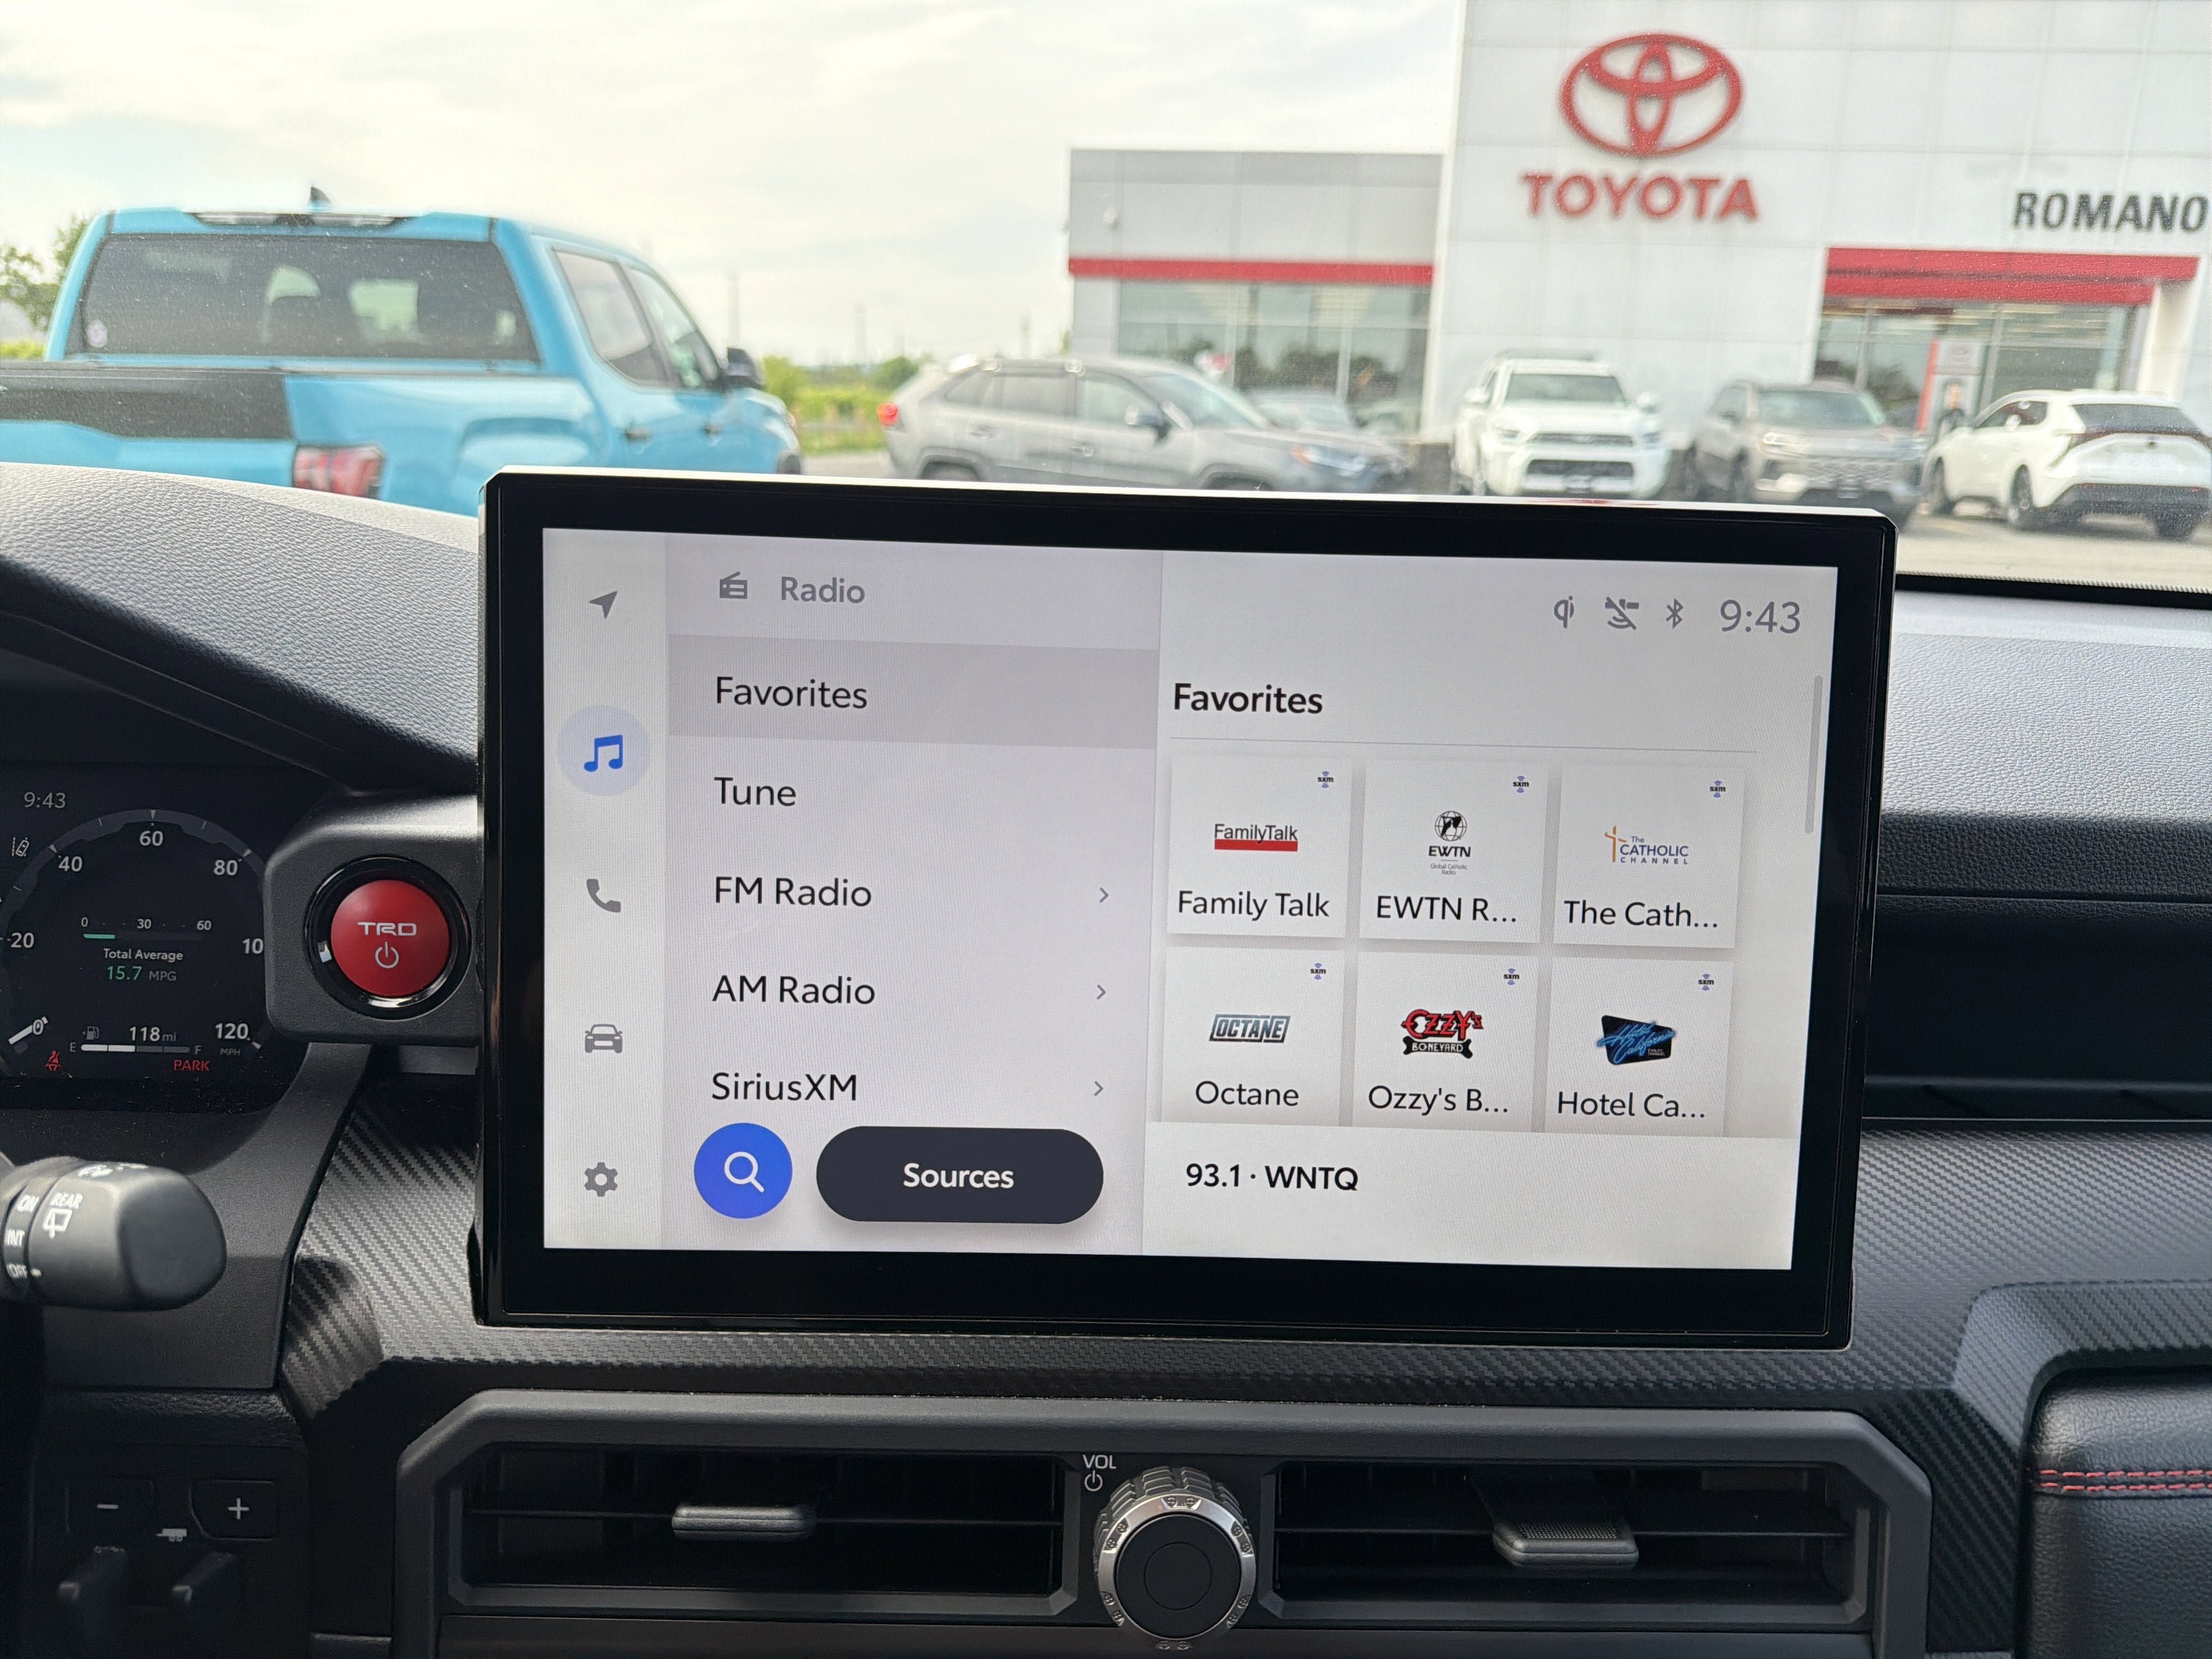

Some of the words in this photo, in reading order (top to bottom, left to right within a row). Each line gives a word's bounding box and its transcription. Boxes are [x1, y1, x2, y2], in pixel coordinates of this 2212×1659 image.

[1522, 173, 1759, 221] TOYOTA
[2013, 191, 2209, 233] ROMANO
[781, 576, 865, 604] Radio
[1720, 599, 1801, 634] 9:43
[716, 676, 867, 709] Favorites
[1174, 682, 1323, 714] Favorites
[714, 776, 797, 806] Tune
[24, 792, 66, 809] 9:43
[139, 830, 163, 847] 60
[1214, 823, 1298, 844] FamilyTalk
[1429, 845, 1471, 857] EWTN
[1620, 844, 1689, 857] CATHOLIC
[58, 856, 83, 872] 40
[213, 859, 238, 876] 80
[1620, 856, 1688, 865] CHANNEL
[715, 876, 763, 904] FM
[776, 877, 872, 907] Radio
[1178, 890, 1268, 921] Family
[1275, 892, 1329, 917] Talk
[1377, 895, 1462, 921] EWTN
[1564, 899, 1616, 925] The
[81, 917, 88, 927] 0
[137, 918, 151, 929] 30
[196, 920, 212, 930] 60
[357, 922, 417, 936] TRD
[10, 932, 35, 949] 20
[242, 938, 263, 954] 10
[103, 948, 132, 959] Total
[134, 949, 184, 963] Average
[107, 966, 142, 980] 15.7
[149, 970, 177, 981] MPG
[712, 975, 766, 1003] AM
[780, 975, 876, 1005] Radio
[33, 1019, 44, 1035] 0
[129, 1026, 160, 1042] 118
[162, 1032, 177, 1042] mi
[215, 1023, 249, 1040] 120
[1215, 1018, 1285, 1039] OCTANE
[1598, 1021, 1656, 1046] Hotel
[69, 1042, 76, 1052] E
[195, 1045, 202, 1055] F
[219, 1048, 241, 1056] MPH
[1411, 1042, 1464, 1052] BONEYARD
[1613, 1030, 1675, 1064] California
[173, 1059, 210, 1071] PARK
[711, 1071, 858, 1102] SiriusXM
[1195, 1080, 1300, 1107] Octane
[1368, 1085, 1457, 1116] Ozzy's
[1558, 1091, 1636, 1117] Hotel
[902, 1162, 1015, 1189] Sources
[1186, 1163, 1240, 1188] 93.1
[1265, 1165, 1359, 1191] WNTQ
[16, 1194, 40, 1212] ON
[50, 1192, 83, 1209] REAR
[4, 1228, 25, 1247] INT
[1082, 1454, 1117, 1469] VOL
